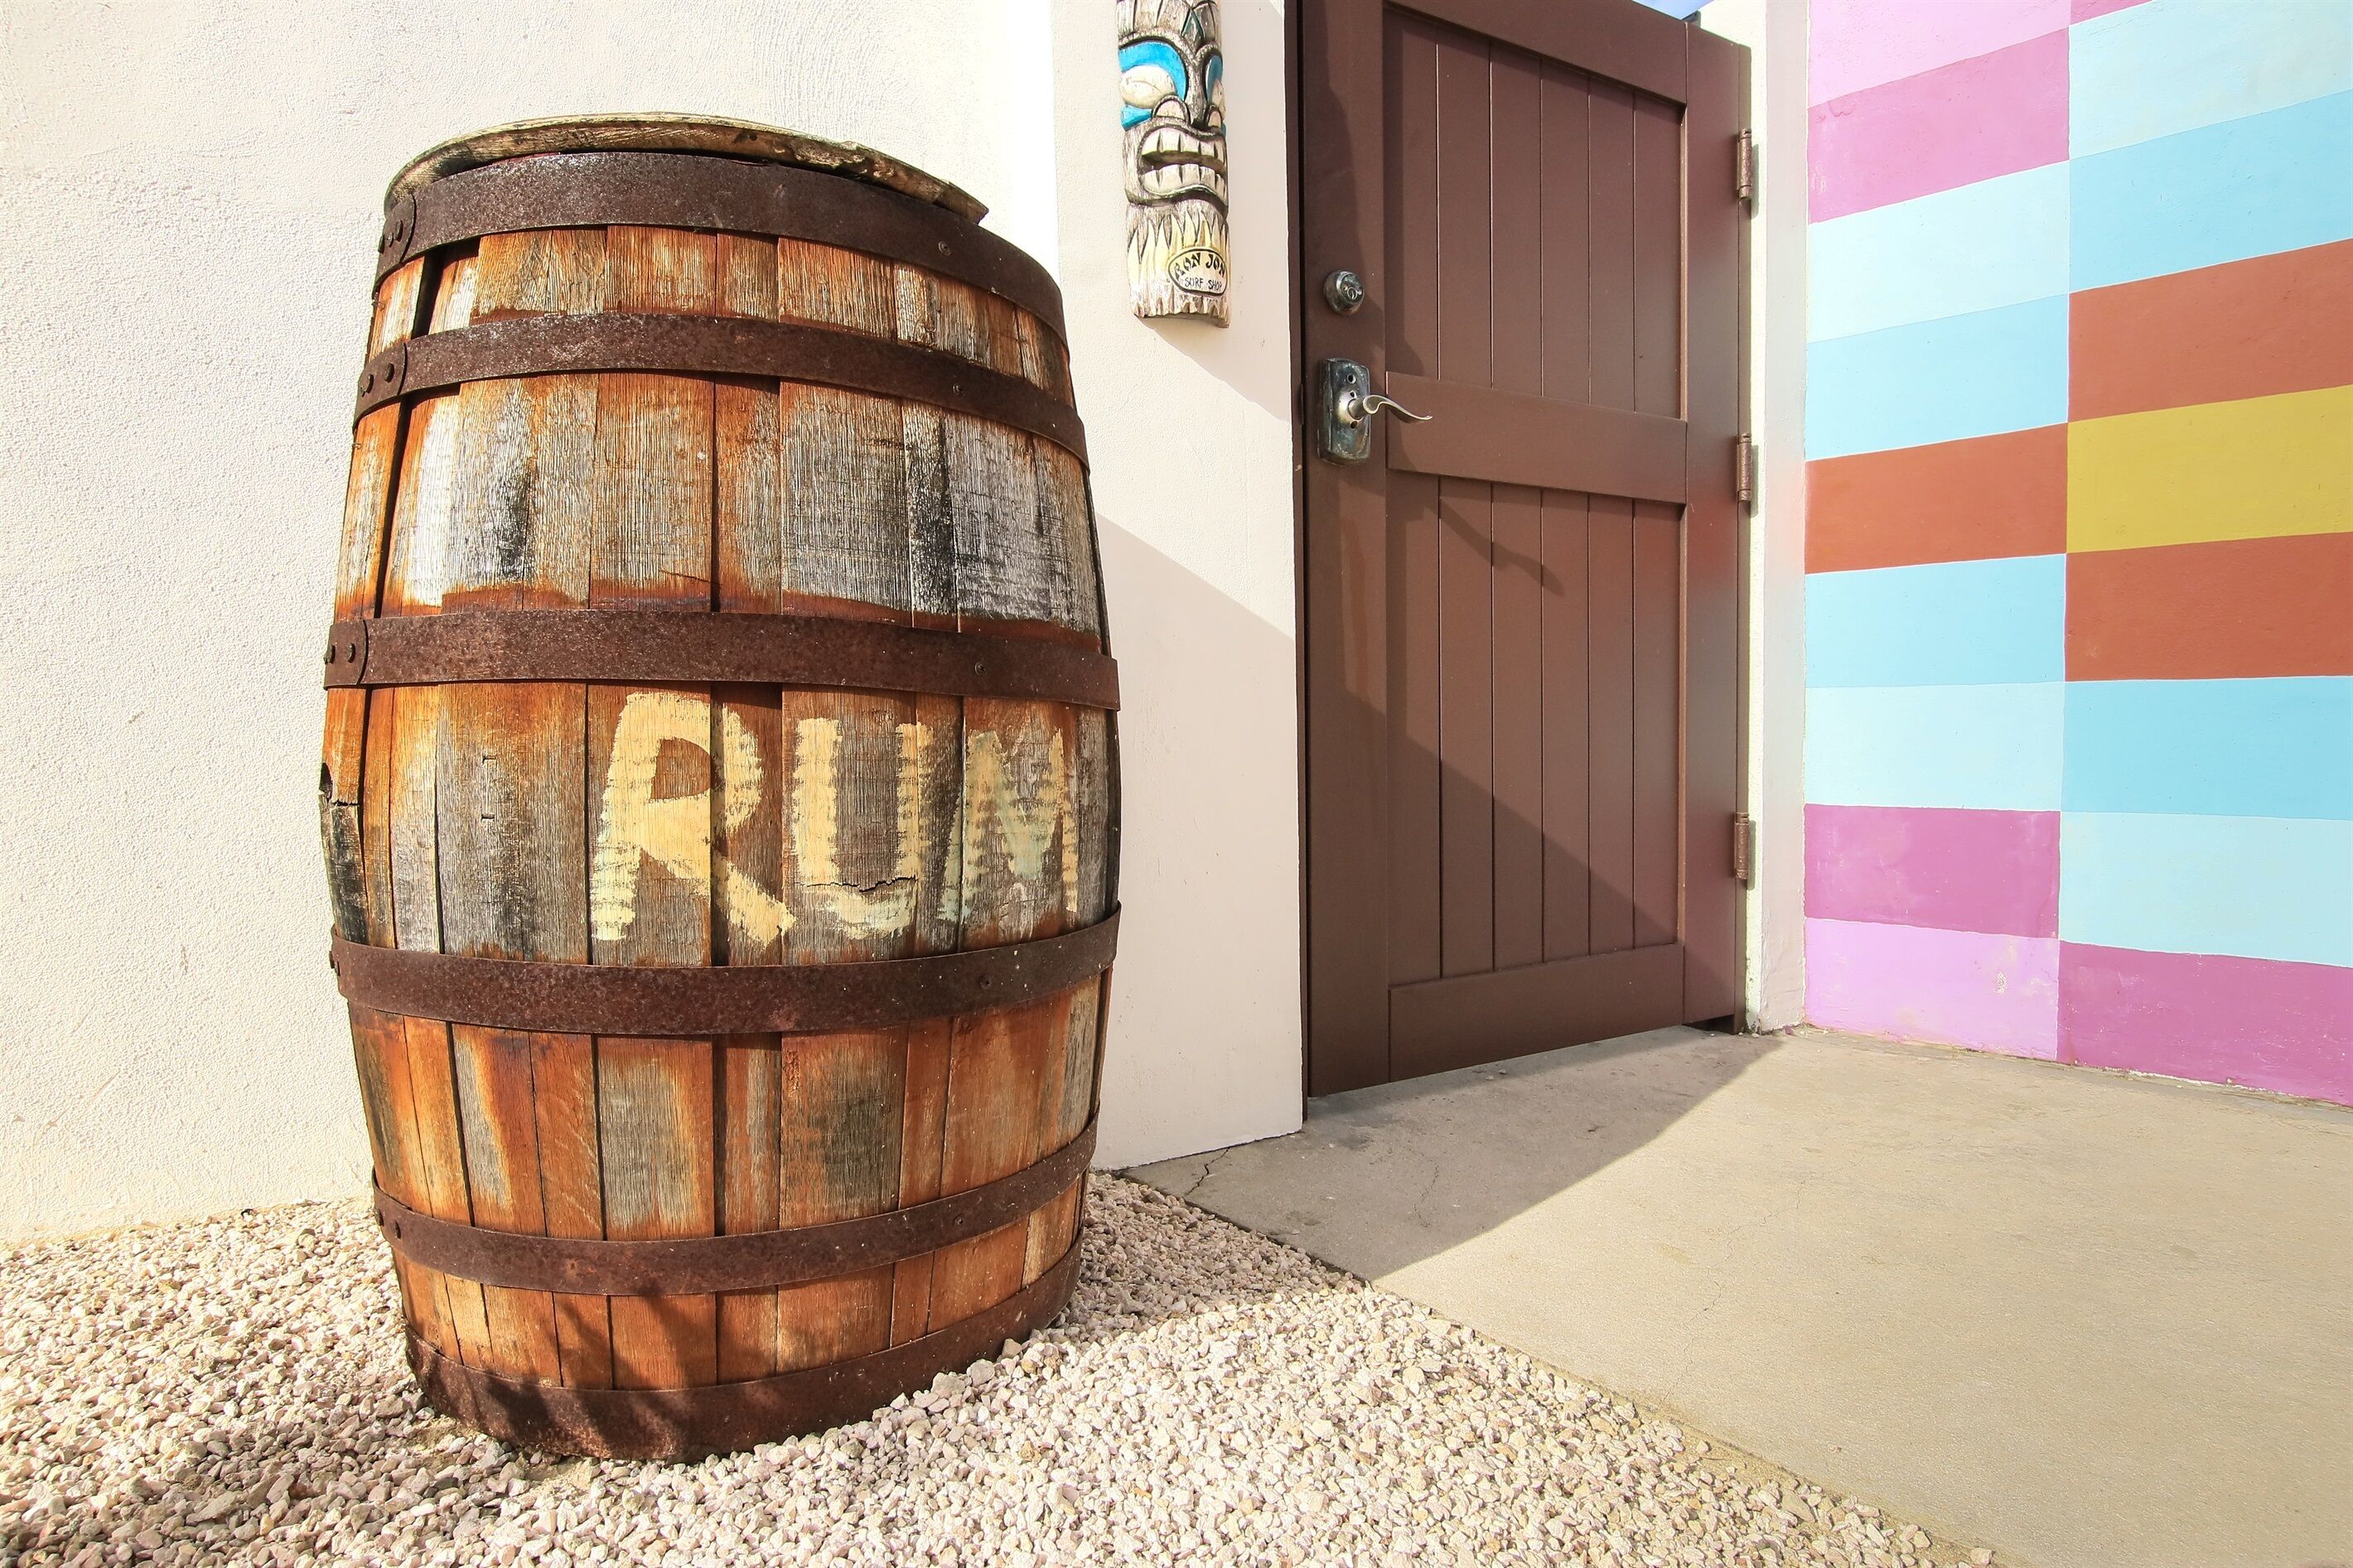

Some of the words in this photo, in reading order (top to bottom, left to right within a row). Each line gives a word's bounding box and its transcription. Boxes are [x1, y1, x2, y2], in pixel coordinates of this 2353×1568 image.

[1174, 252, 1201, 281] RON
[1205, 253, 1225, 277] JON
[1185, 277, 1204, 288] SURF
[1208, 279, 1222, 292] SHOP
[592, 692, 1078, 946] RUM
